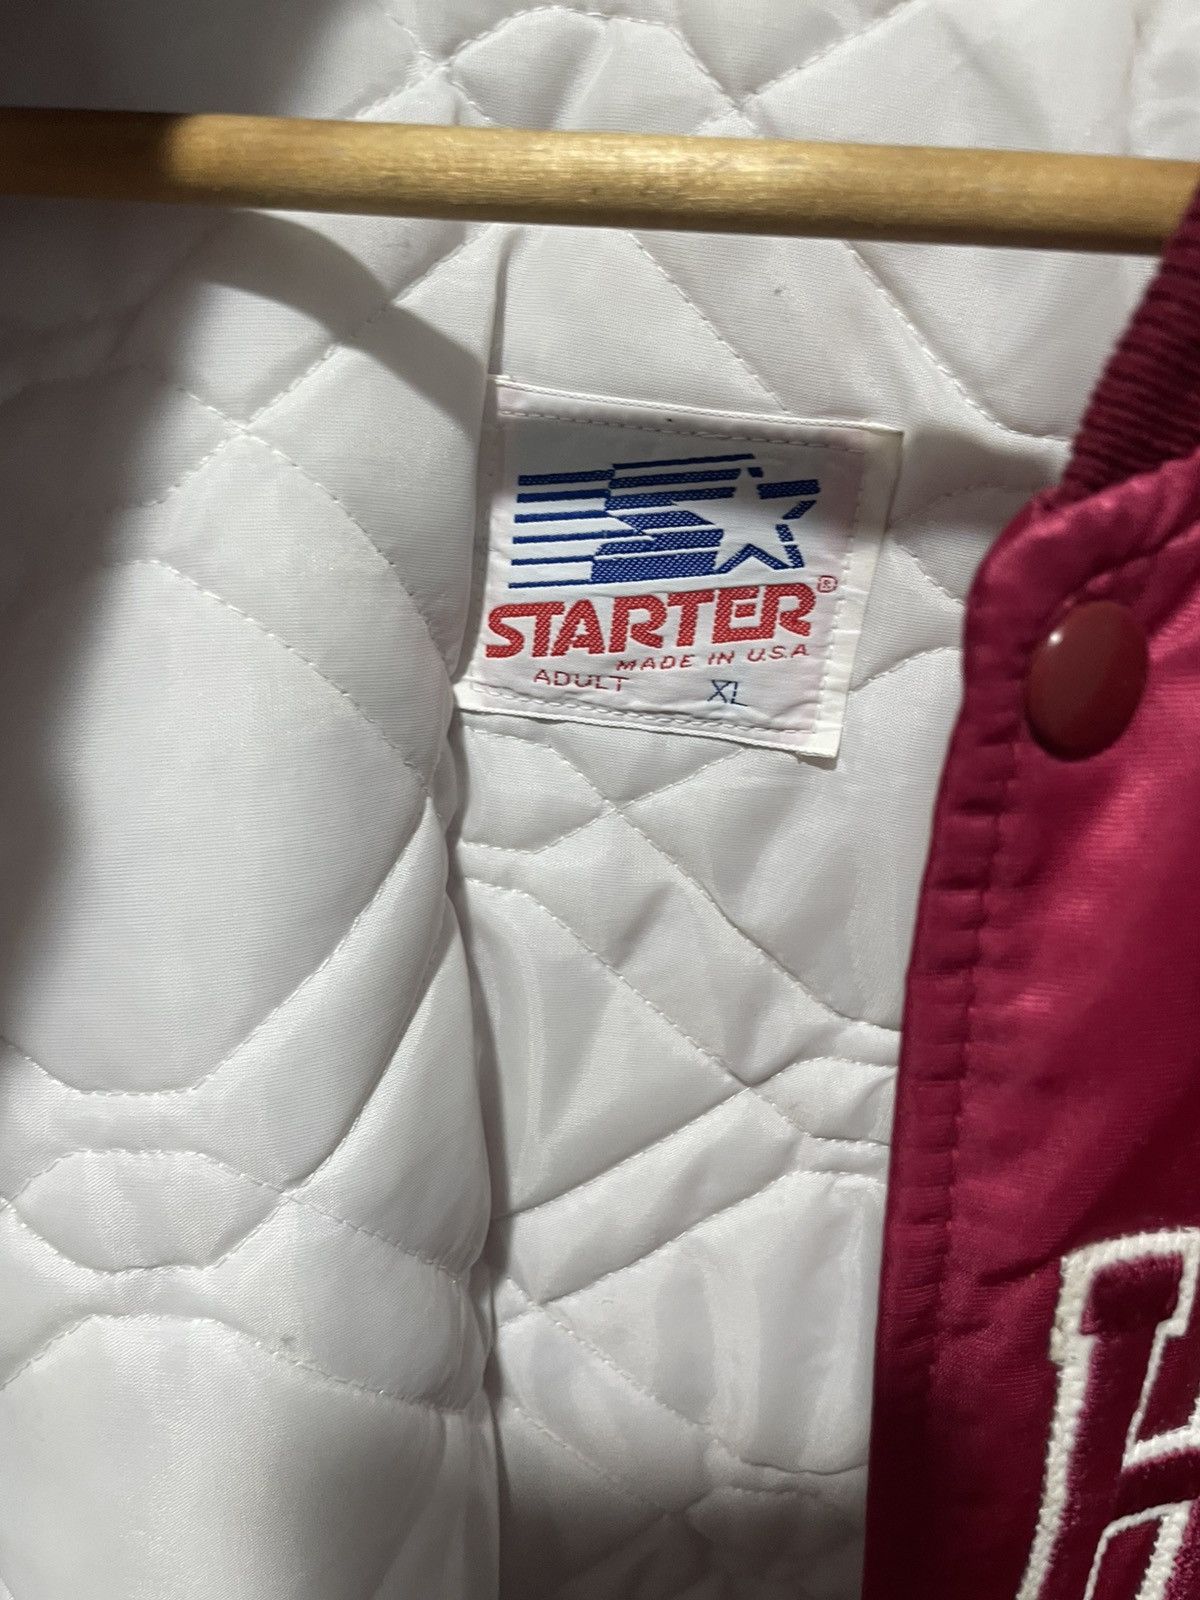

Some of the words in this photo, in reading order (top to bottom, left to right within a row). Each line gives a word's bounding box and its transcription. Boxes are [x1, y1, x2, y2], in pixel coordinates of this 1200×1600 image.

[485, 582, 816, 658] STARTER
[615, 654, 696, 672] MADE
[707, 650, 736, 666] IN
[533, 668, 630, 692] ADULT
[706, 679, 749, 707] XL
